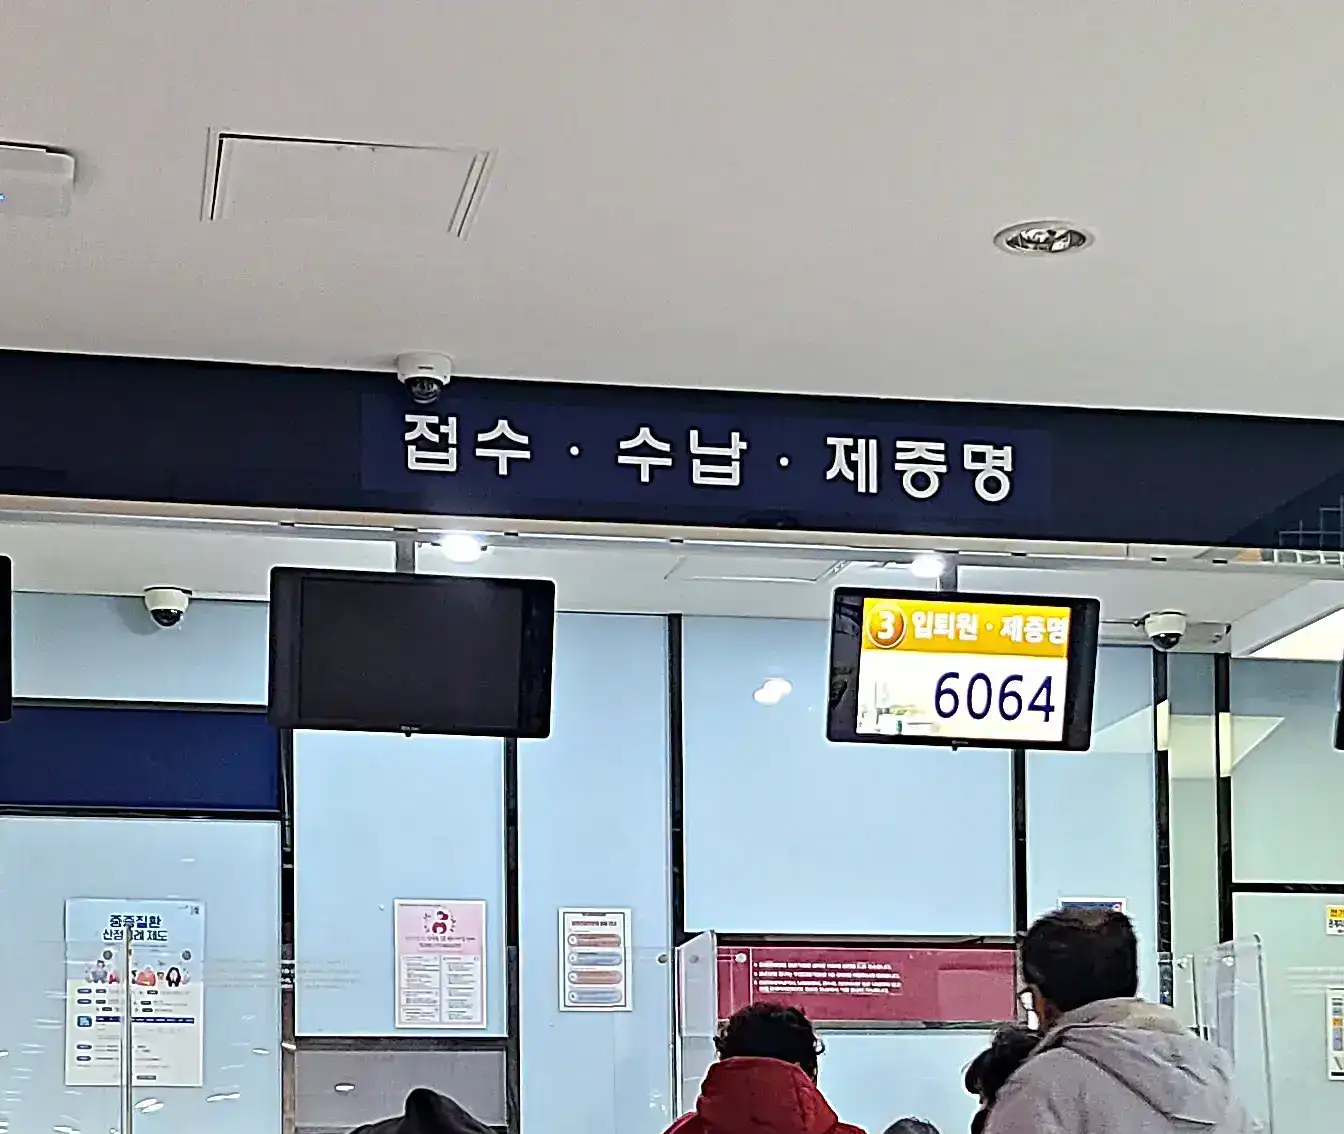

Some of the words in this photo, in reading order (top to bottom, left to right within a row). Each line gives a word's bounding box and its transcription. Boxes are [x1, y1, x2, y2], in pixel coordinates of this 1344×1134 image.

[404, 413, 531, 476] 접수
[617, 426, 748, 487] 수납
[826, 434, 1013, 502] 제증명
[877, 611, 896, 640] 3
[911, 610, 978, 641] 입퇴원
[999, 615, 1068, 646] 제증명
[934, 671, 1056, 723] 6064
[103, 929, 144, 941] 산정례
